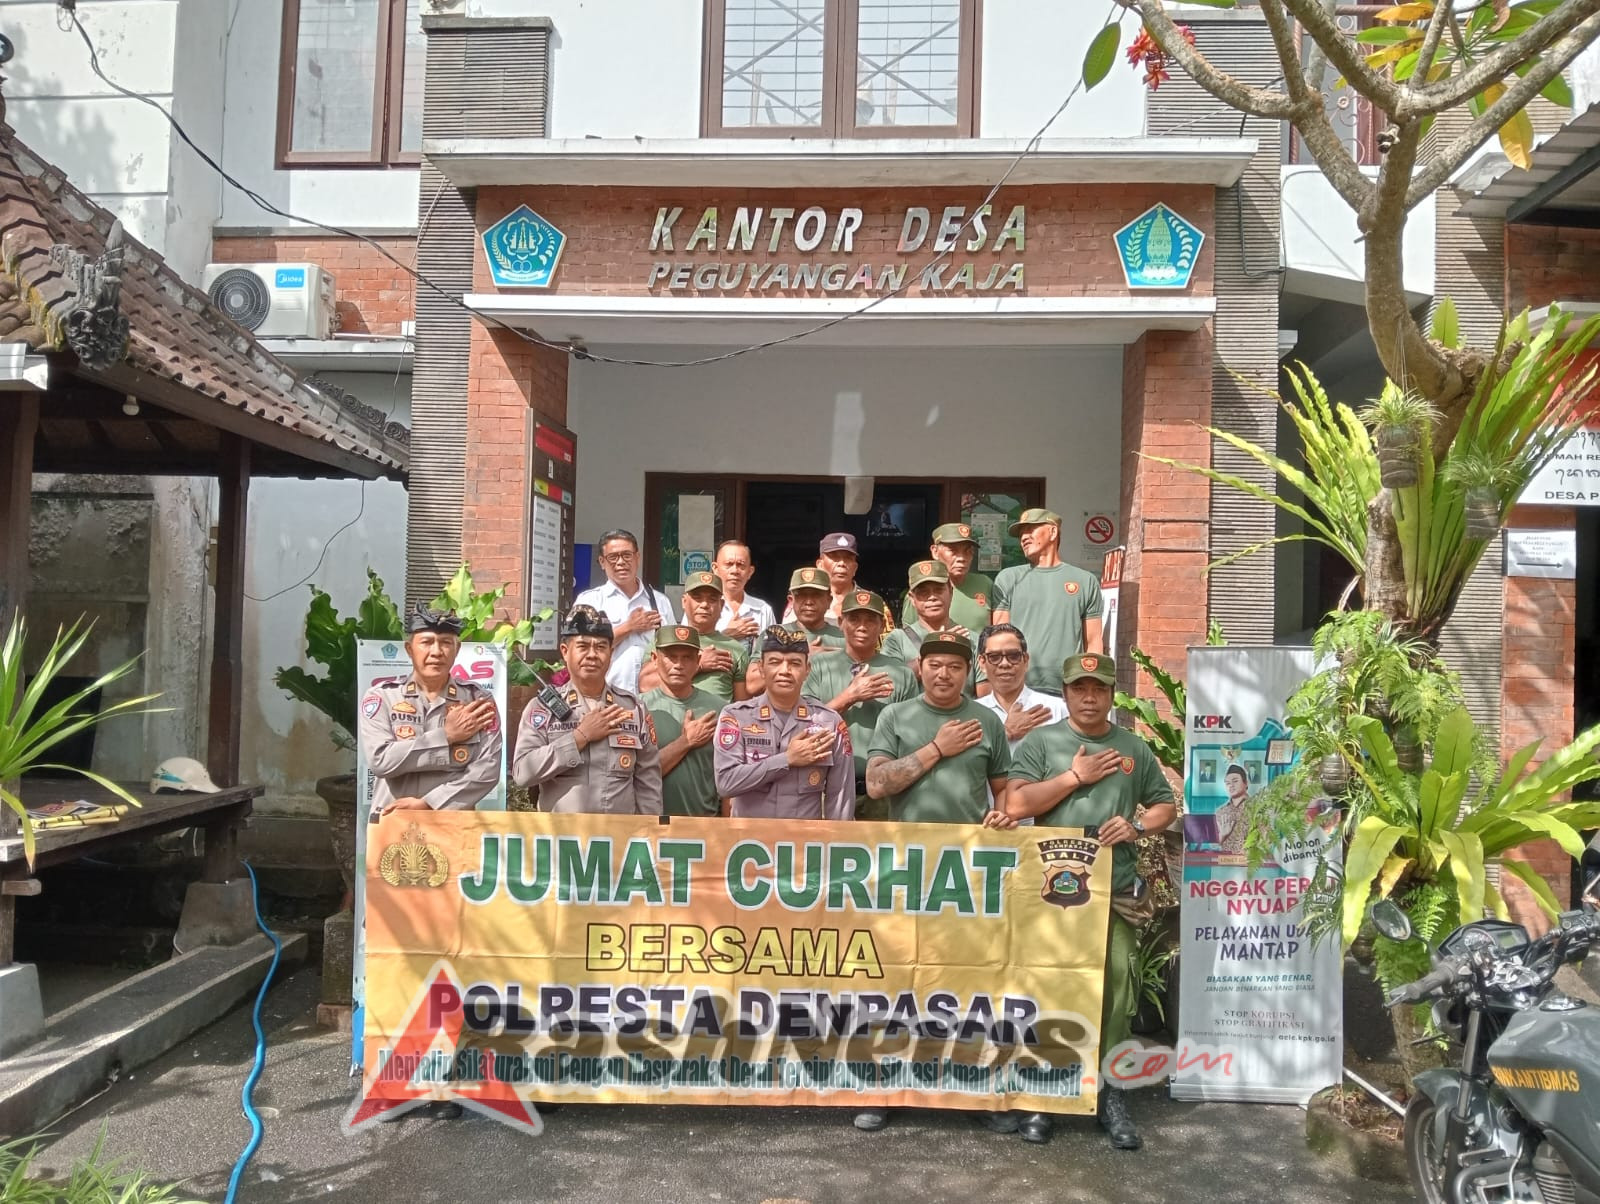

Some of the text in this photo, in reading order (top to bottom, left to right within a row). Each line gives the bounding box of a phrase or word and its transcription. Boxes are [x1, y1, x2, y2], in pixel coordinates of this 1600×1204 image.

[648, 204, 1025, 252] KANTOR DESA
[647, 262, 1025, 291] PEGUYANGAN KAJA
[1545, 491, 1585, 501] DESA
[1193, 715, 1232, 729] KPK
[1046, 851, 1089, 861] BALI
[458, 834, 1018, 915] JUMAT CURHAT
[1190, 879, 1268, 898] NGGAK
[1195, 925, 1281, 941] PELAYANAN
[585, 922, 885, 979] BERSAMA
[1219, 941, 1300, 962] MANTAP
[1206, 975, 1253, 984] BIASAKAN
[428, 982, 1040, 1044] POLRESTA DENPASAR
[1224, 1009, 1296, 1020] STOP KORUPSI
[1214, 1018, 1305, 1030] STOP GRATIFIKASI
[559, 1053, 625, 1089] Dengan
[628, 1053, 727, 1091] Masyarakat
[729, 1056, 773, 1090] Demi
[942, 1058, 990, 1093] Aman
